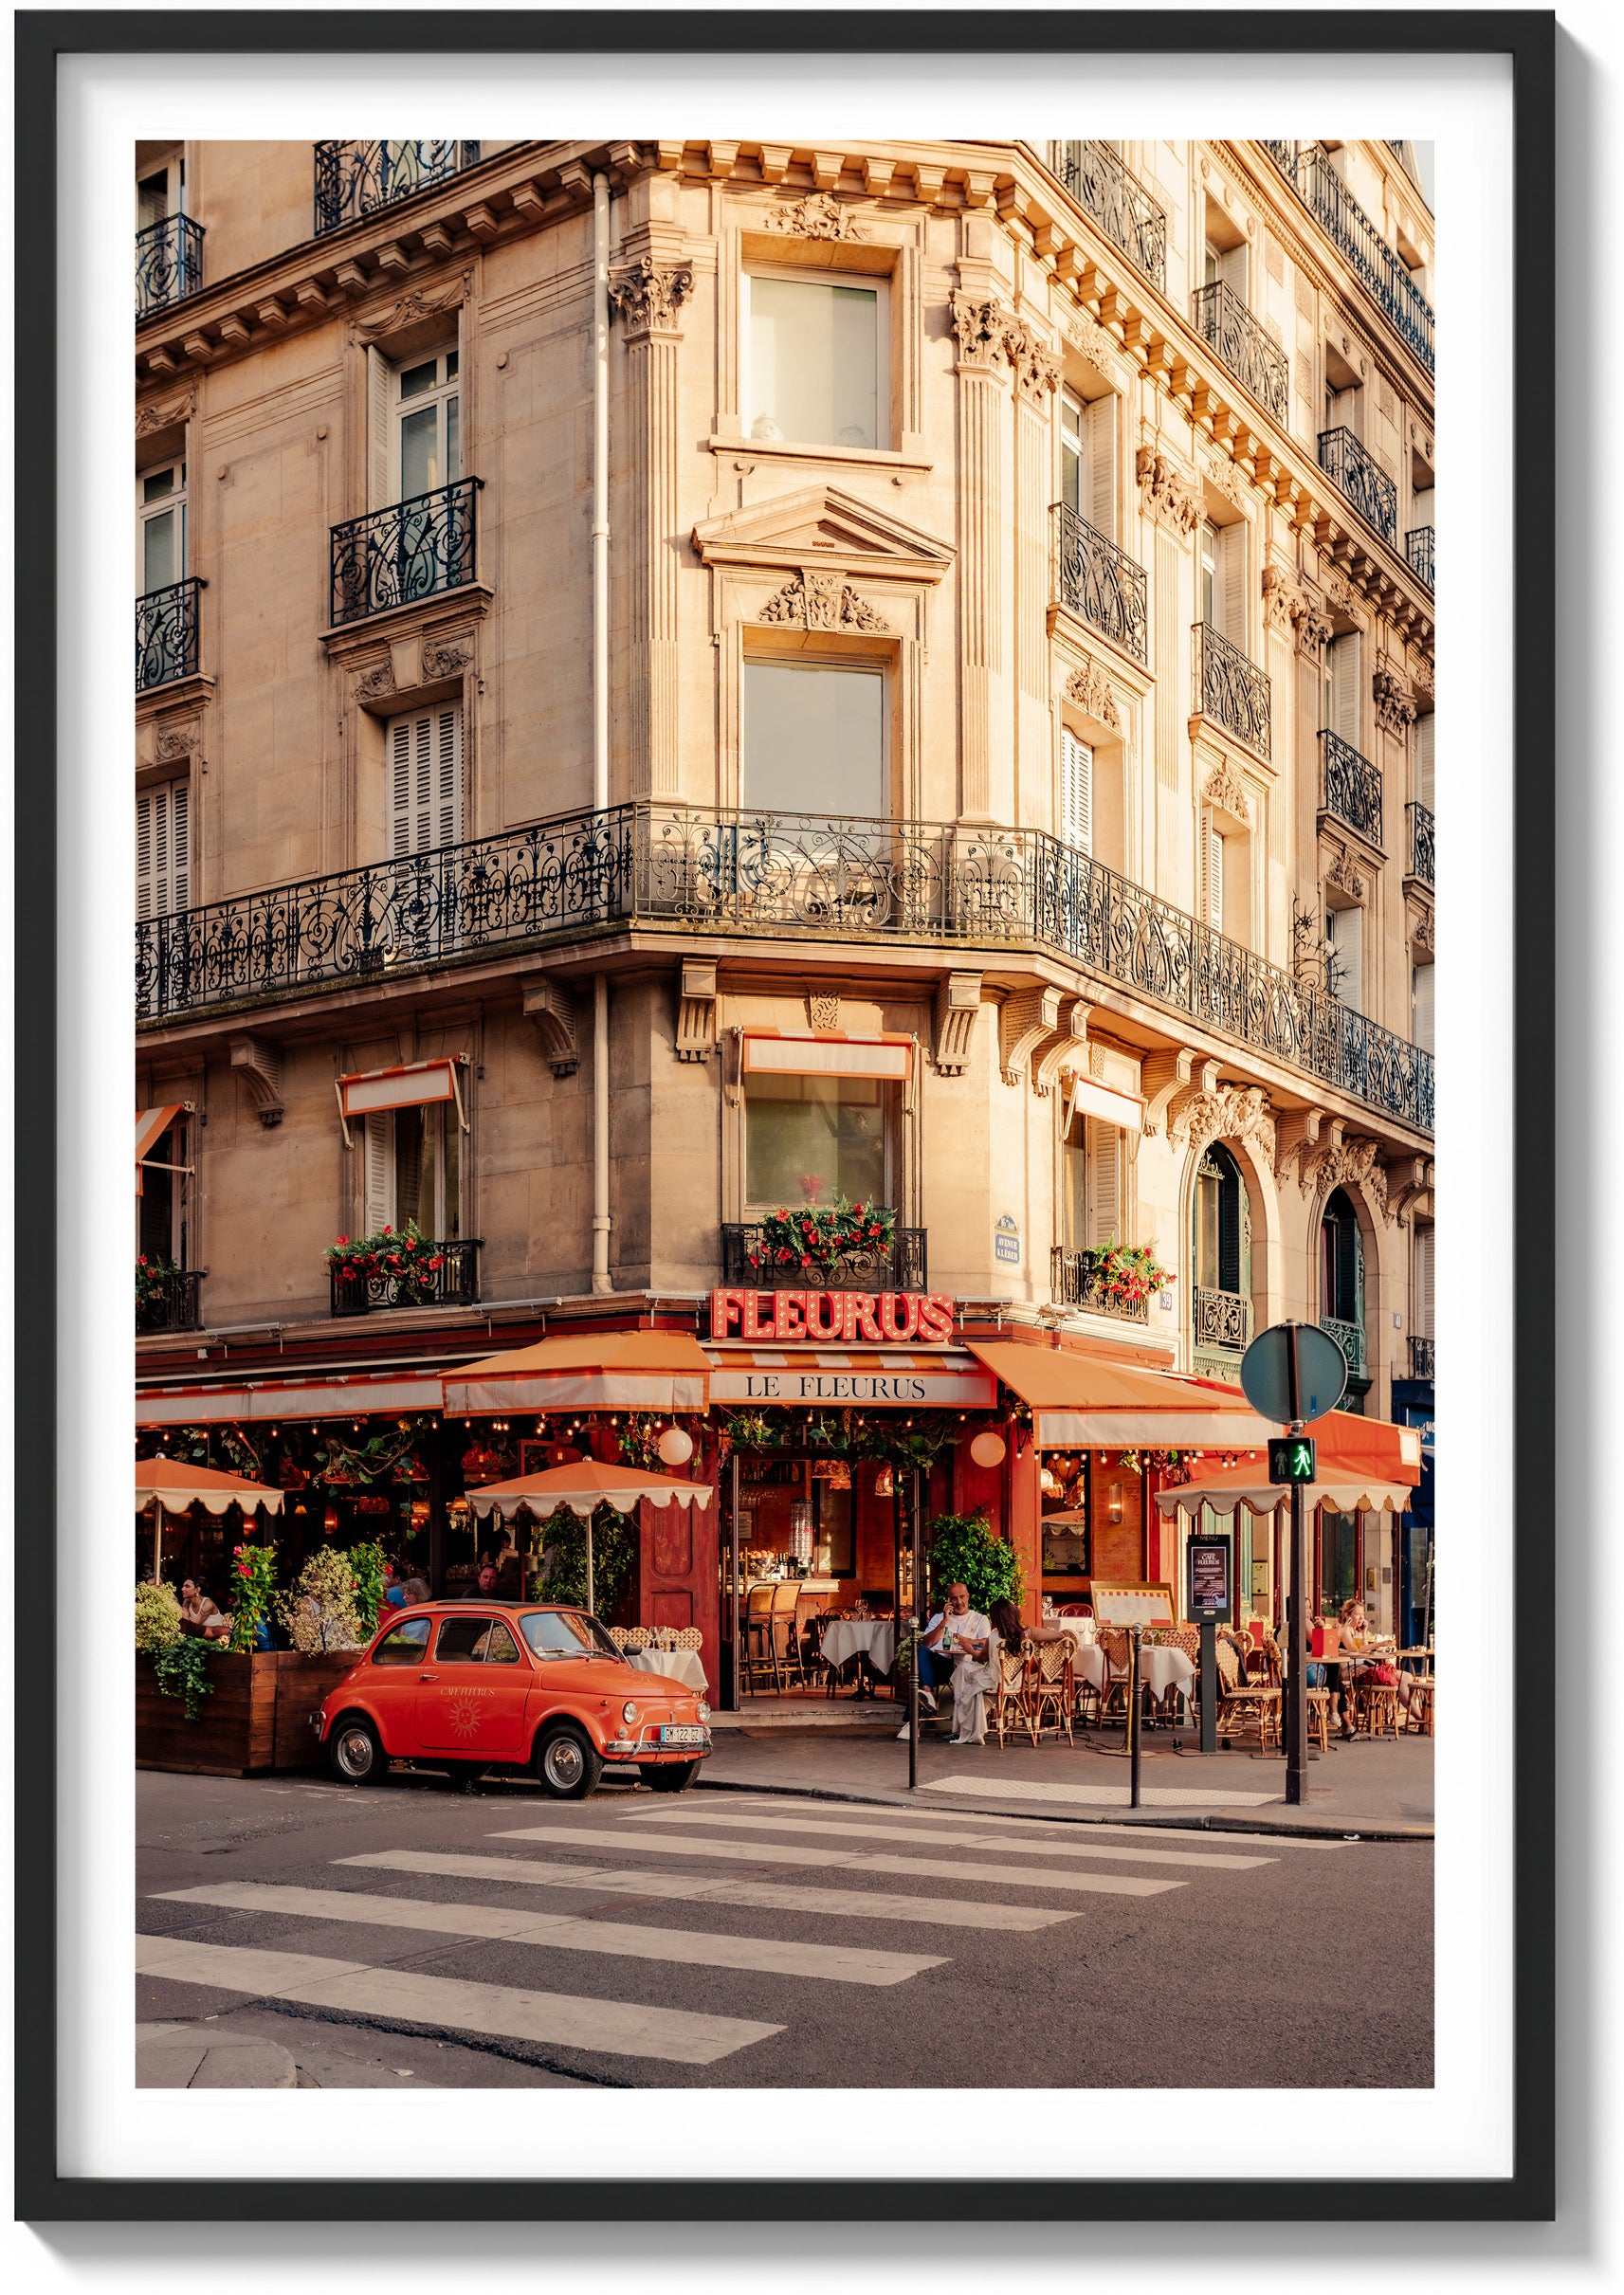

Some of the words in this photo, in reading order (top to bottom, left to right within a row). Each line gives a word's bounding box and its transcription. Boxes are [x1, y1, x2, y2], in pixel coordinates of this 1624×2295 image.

[998, 1238, 1017, 1249] AVENUE
[997, 1248, 1017, 1260] KLÉBER
[1162, 1293, 1171, 1308] 39
[712, 1288, 954, 1341] FLEURUS
[746, 1376, 780, 1397] LE
[800, 1377, 925, 1400] FLEURUS
